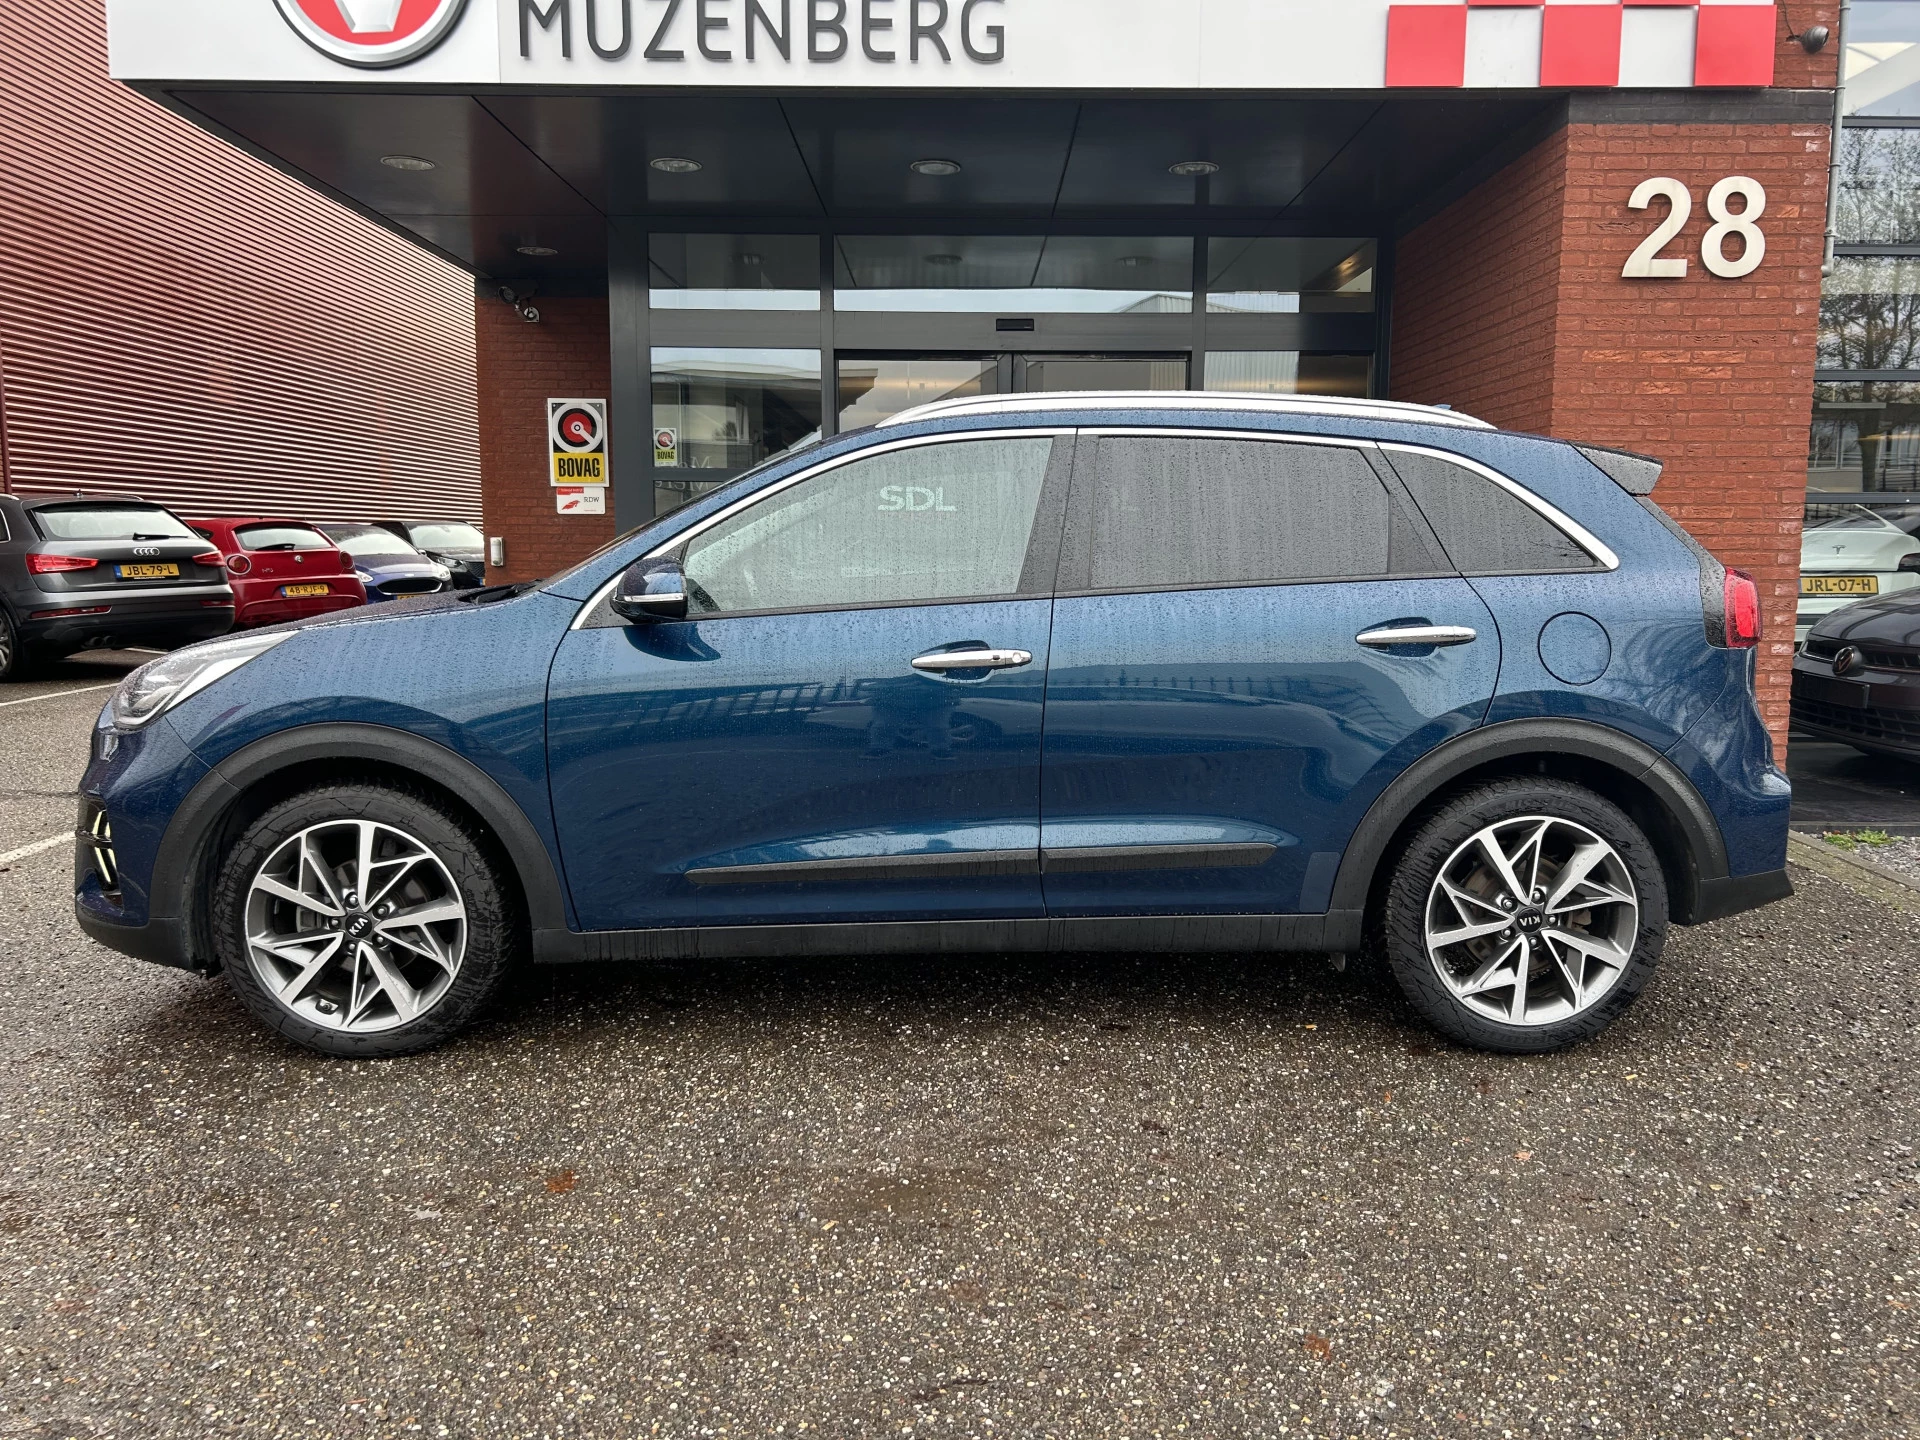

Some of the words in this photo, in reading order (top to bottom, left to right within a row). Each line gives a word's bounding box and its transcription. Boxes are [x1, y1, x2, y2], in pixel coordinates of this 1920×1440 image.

[518, 0, 1005, 61] MUZENBERG
[1621, 175, 1767, 278] 28
[657, 451, 675, 460] BOVAG
[557, 457, 601, 478] BOVAG
[877, 485, 958, 512] SDL
[126, 564, 175, 576] JBL-79-L
[289, 584, 326, 595] 48-RJF-9
[1806, 578, 1872, 592] JRL-07-H
[349, 917, 369, 935] KIA
[1519, 915, 1541, 927] KIA
